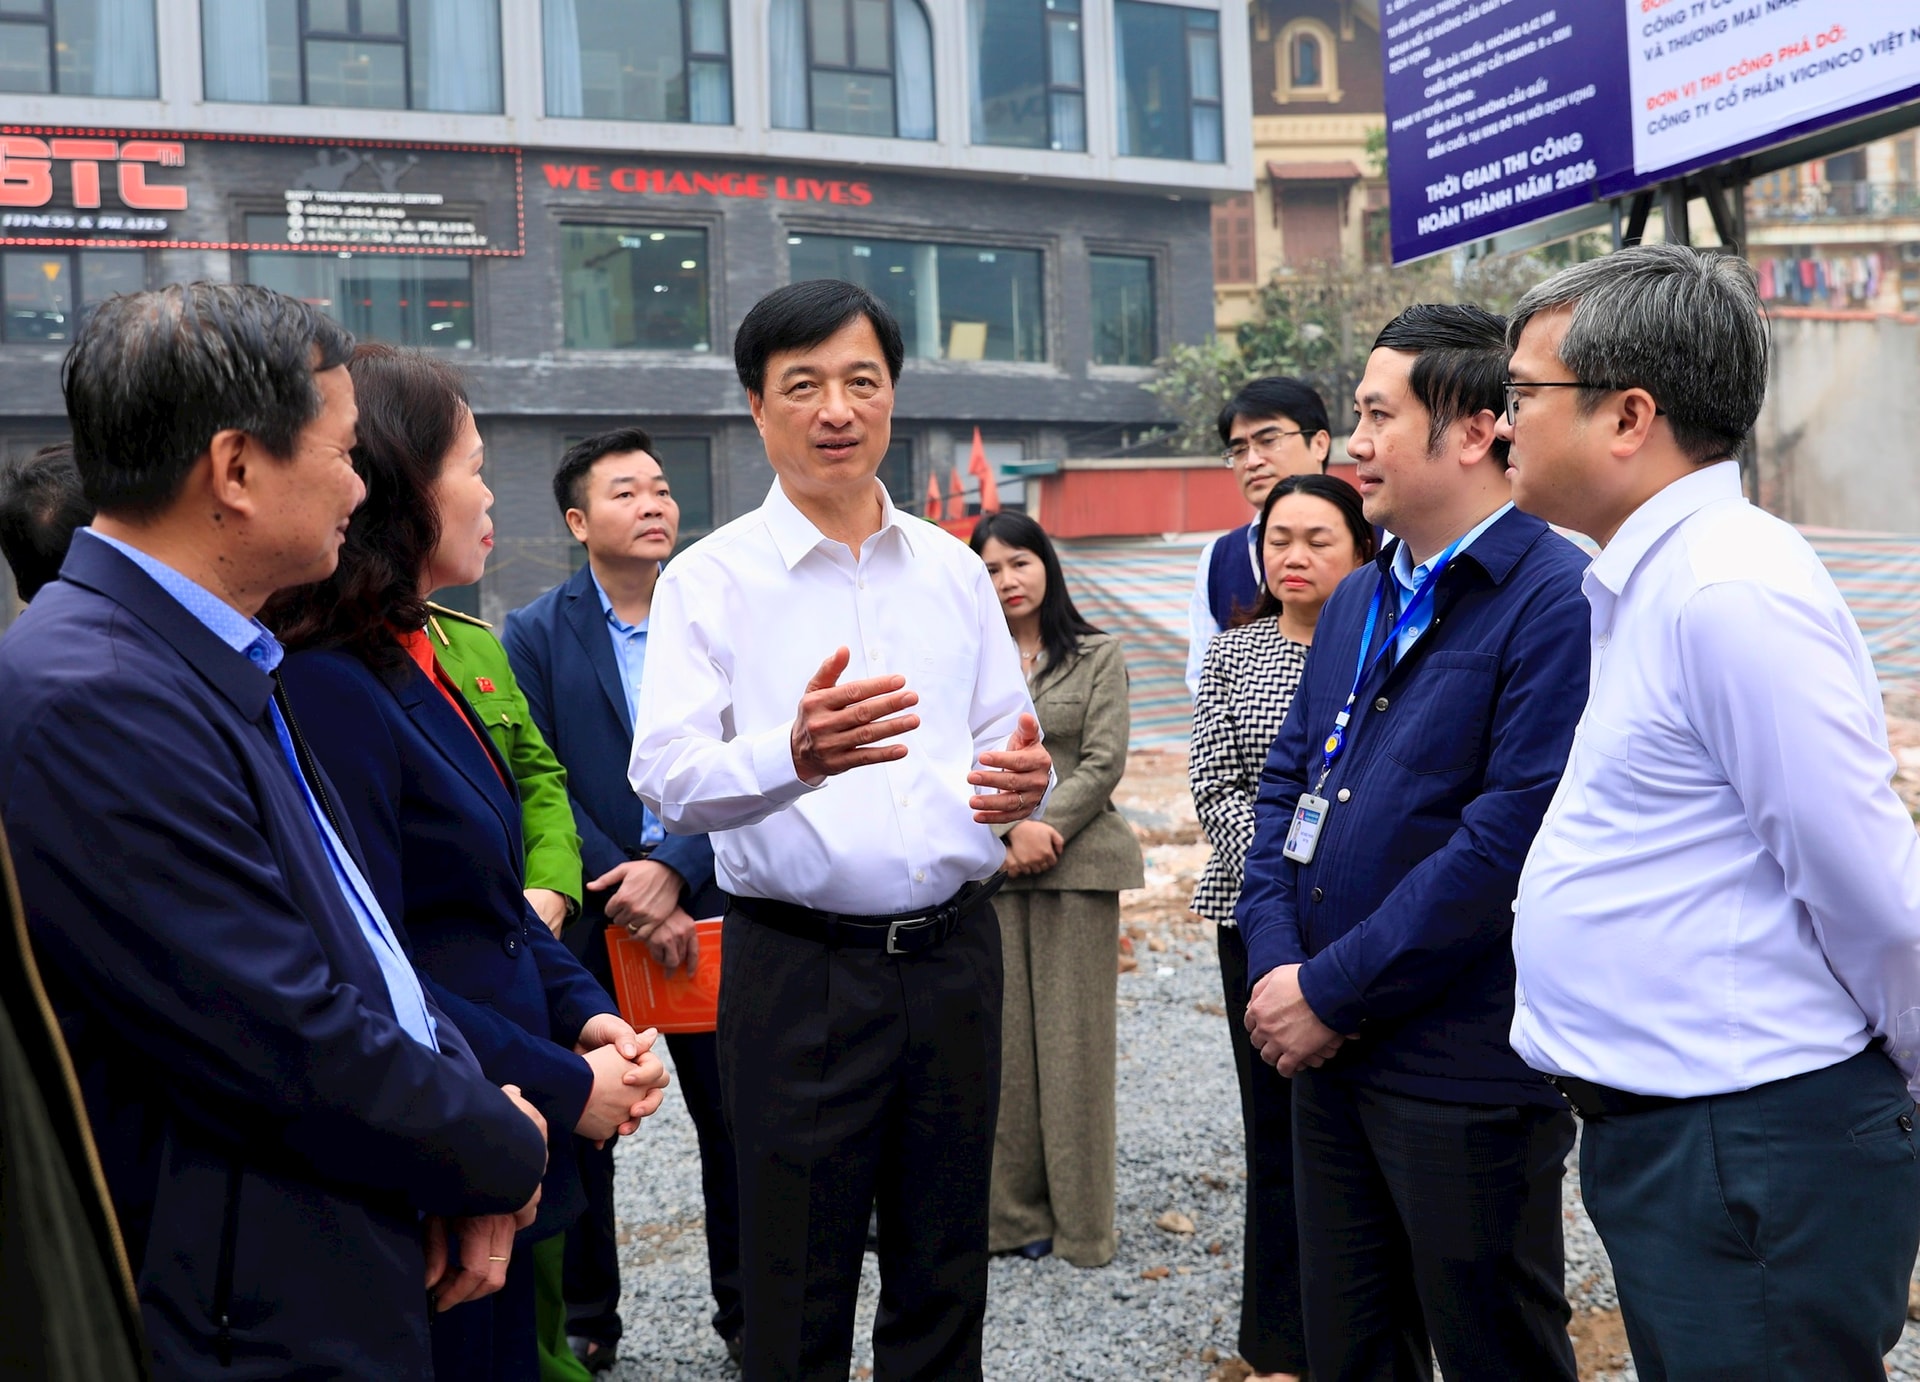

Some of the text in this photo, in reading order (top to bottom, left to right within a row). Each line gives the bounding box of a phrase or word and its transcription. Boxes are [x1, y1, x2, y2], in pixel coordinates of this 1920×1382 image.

[1642, 9, 1687, 37] CÔNG
[1690, 2, 1704, 18] TY
[1643, 41, 1665, 61] VÀ
[1667, 18, 1728, 53] THƯƠNG
[1732, 4, 1761, 27] MẠI
[1646, 89, 1679, 111] ĐƠN
[1682, 81, 1697, 99] VỊ
[1700, 72, 1722, 91] THI
[1726, 53, 1774, 81] CÔNG
[1647, 109, 1691, 135] CÔNG
[1695, 102, 1710, 118] TY
[1715, 83, 1738, 111] CỔ
[1743, 72, 1785, 101] PHẦN
[1790, 48, 1863, 83] VICINCO
[1869, 31, 1905, 56] VIỆT
[543, 163, 873, 207] WE CHANGE LIVES
[1425, 132, 1583, 203] THỜI GIAN THI CÔNG
[2, 213, 168, 231] FITNESS & PILATES
[1417, 158, 1597, 235] HOÀN THÀNH NĂM 2026
